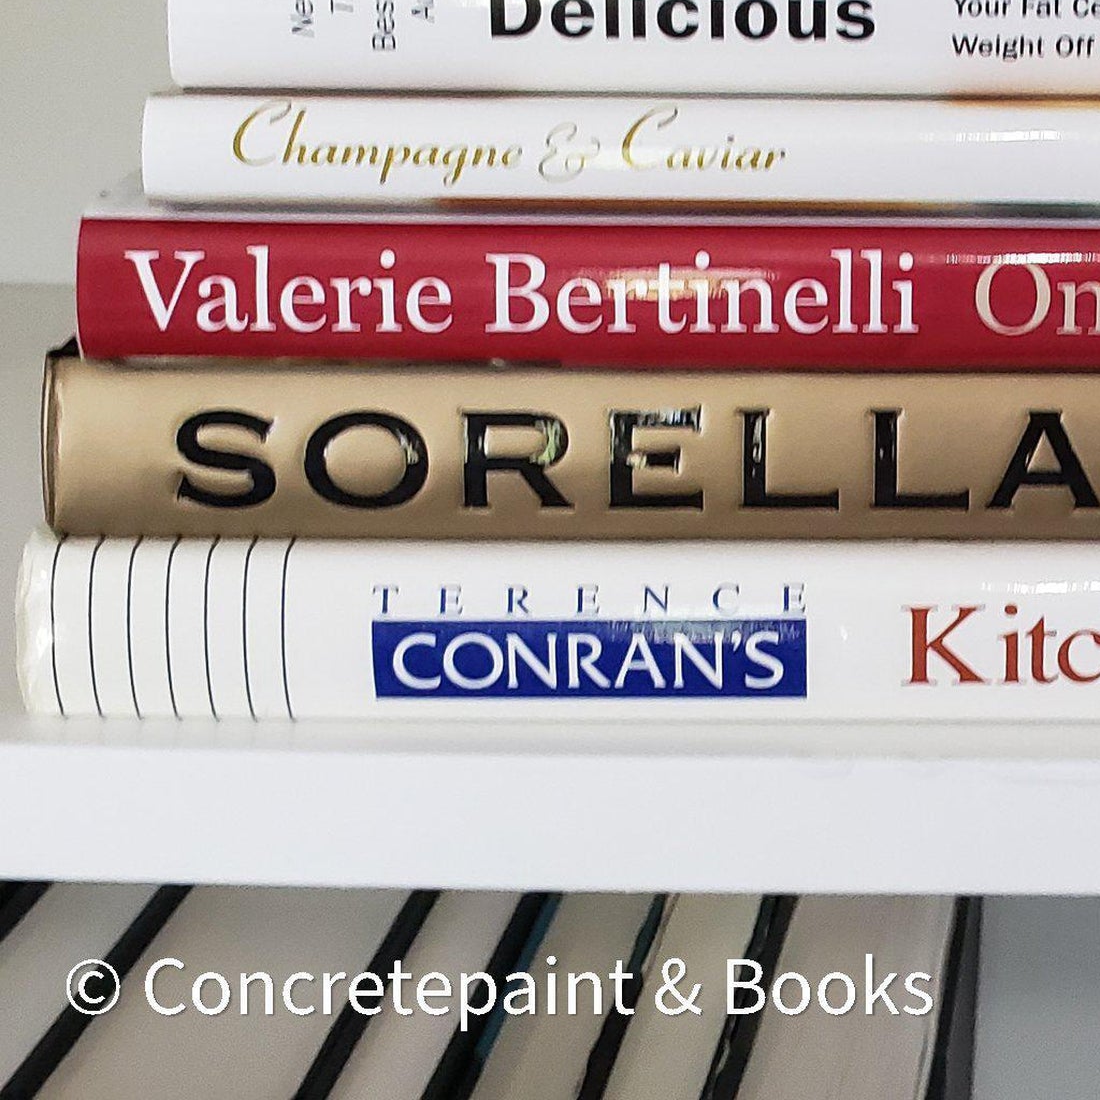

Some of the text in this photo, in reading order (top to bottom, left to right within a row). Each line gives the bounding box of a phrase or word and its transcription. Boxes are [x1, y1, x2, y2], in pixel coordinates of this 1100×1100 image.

[952, 34, 1043, 61] Weight
[1055, 34, 1094, 58] Off
[232, 101, 786, 186] Champagne & Caviar
[125, 245, 920, 336] Valerie Bertinelli
[372, 583, 807, 615] TERENCE
[392, 630, 785, 690] CONRAN'S
